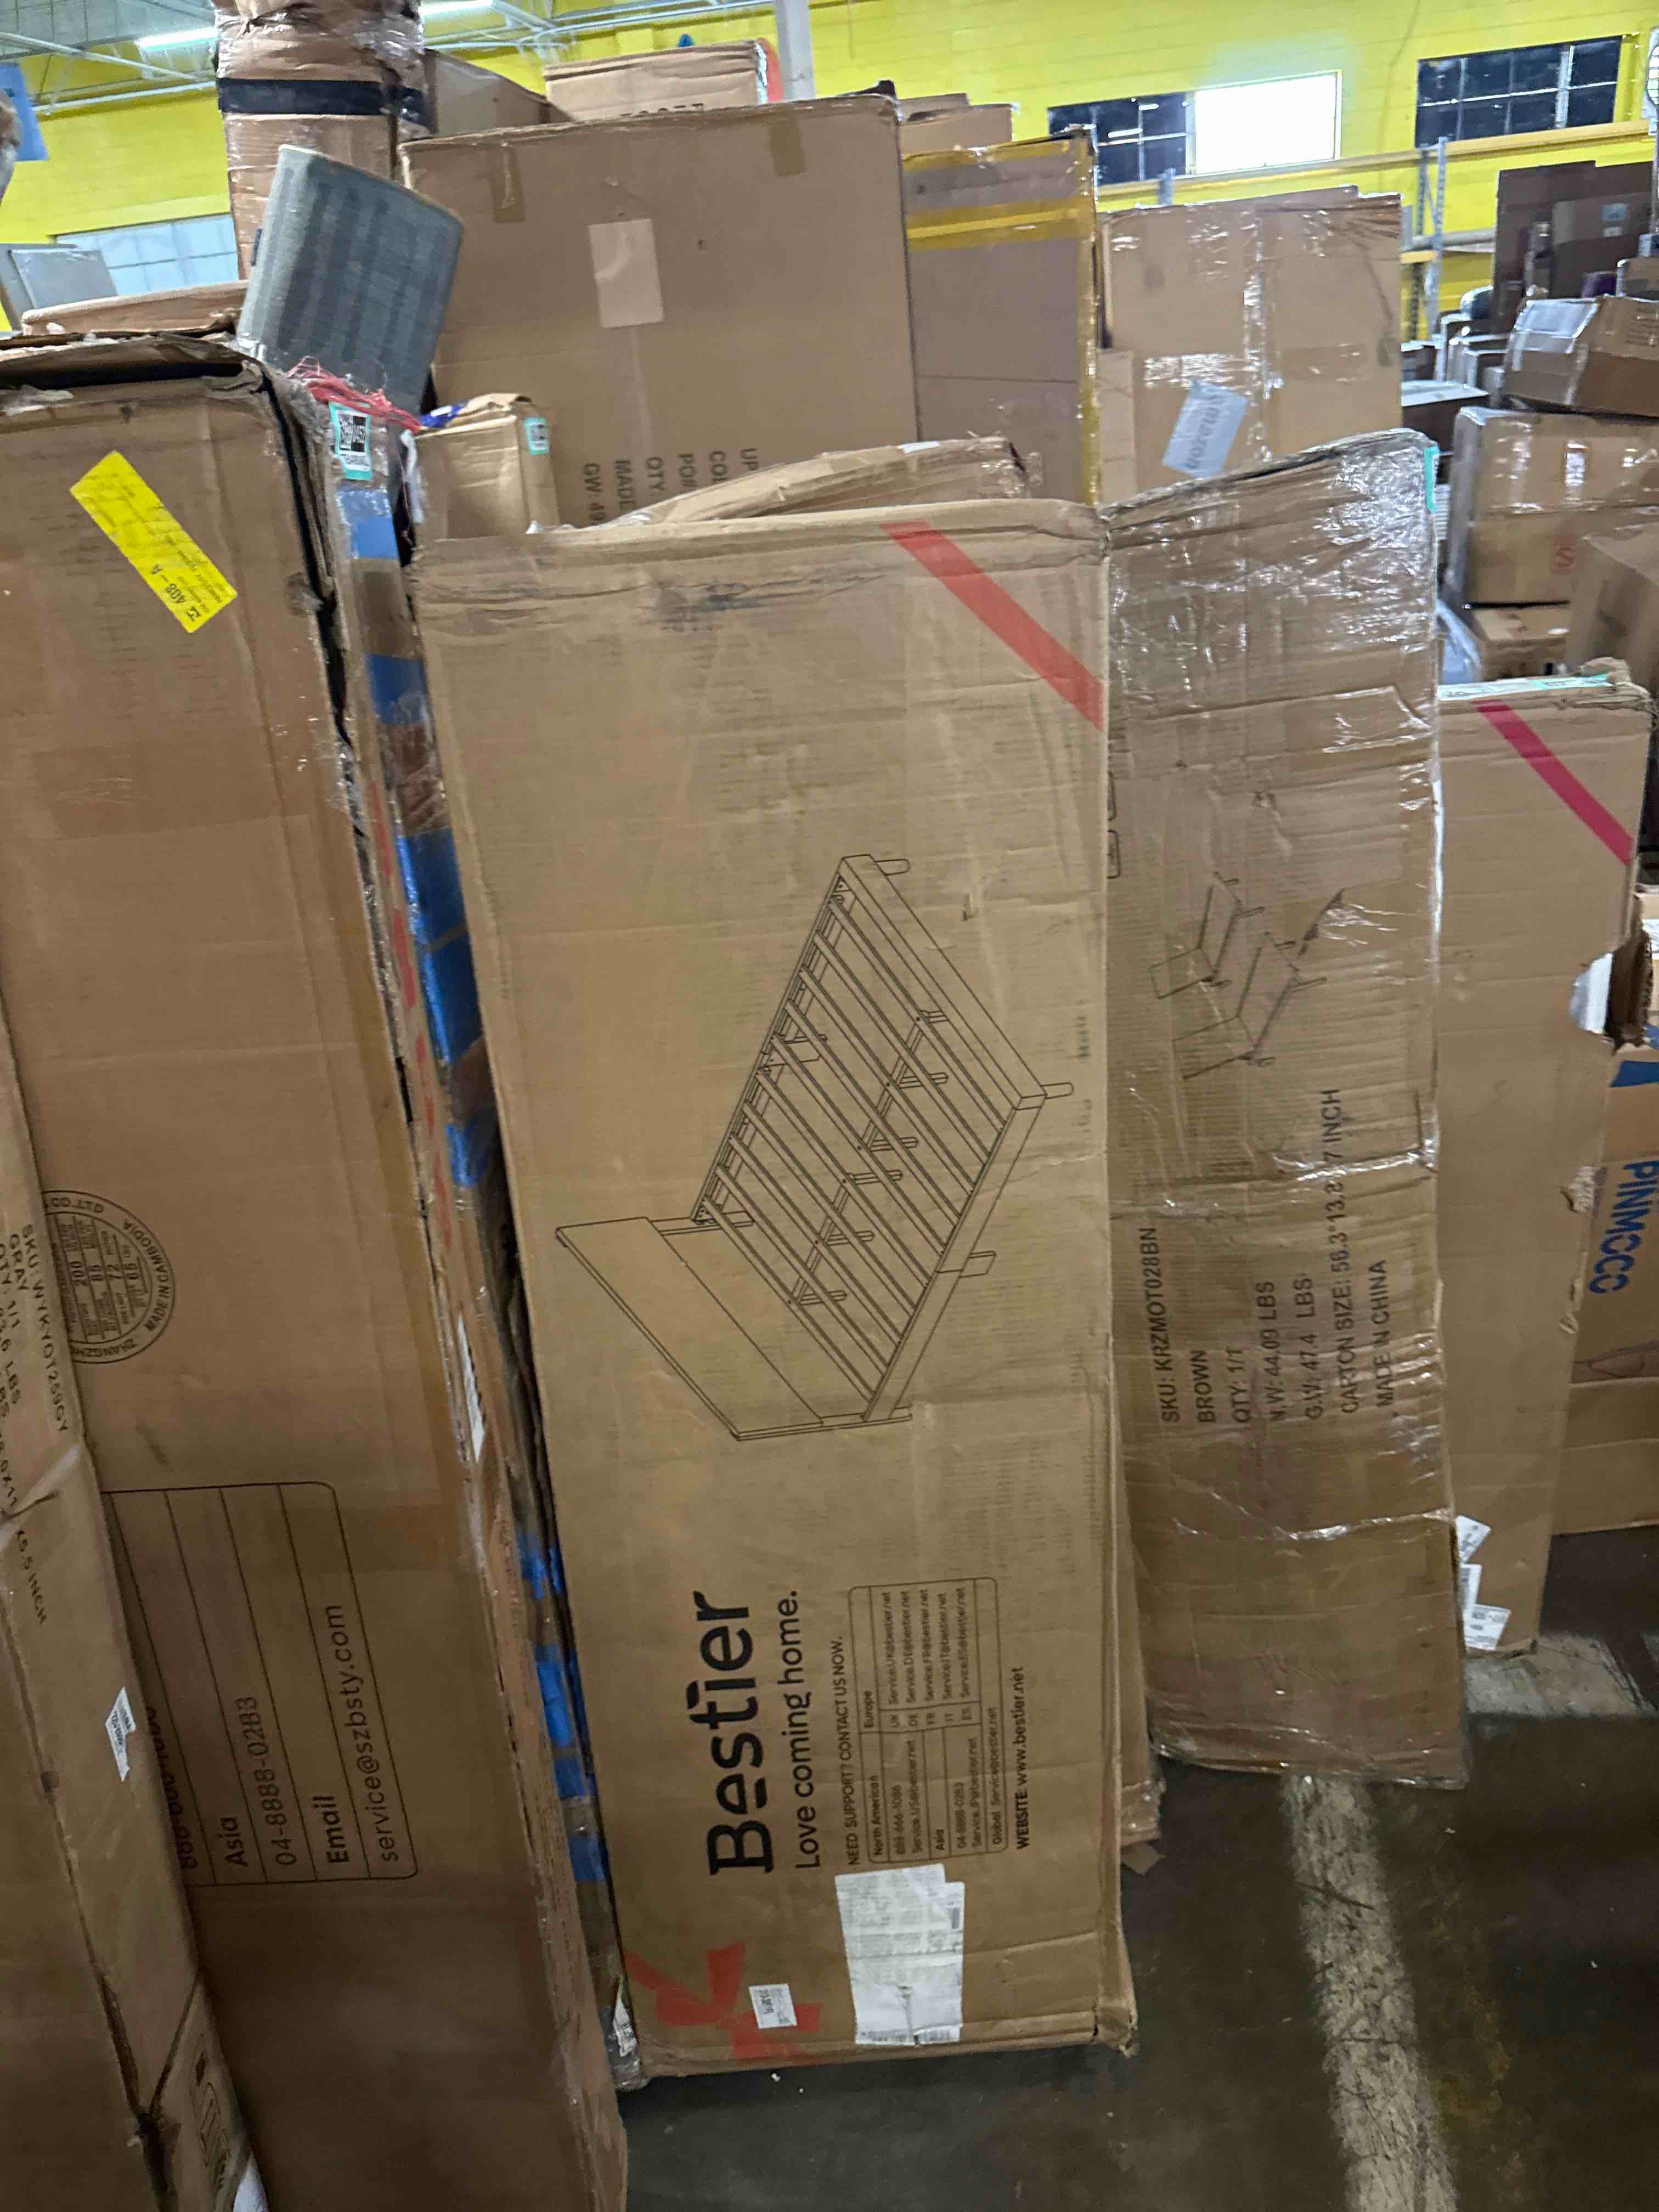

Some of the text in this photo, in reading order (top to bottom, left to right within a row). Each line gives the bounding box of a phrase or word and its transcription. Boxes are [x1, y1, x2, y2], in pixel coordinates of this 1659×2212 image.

[1321, 1089, 1344, 1144] INCH
[1255, 1281, 1278, 1321] LBS
[1293, 1277, 1315, 1318] LBS
[1331, 1280, 1355, 1331] SIZE:
[1368, 1259, 1390, 1325] CHINA
[1159, 1377, 1180, 1423] SKU:
[1189, 1350, 1216, 1423] BROWN
[1226, 1347, 1251, 1424] QTY: 1/1
[1337, 1337, 1360, 1414] CARTON
[1373, 1350, 1394, 1408] MADE
[833, 1677, 847, 1697] US
[864, 1691, 874, 1728] Europe
[325, 1604, 400, 1863] service@szbsty.com
[685, 1590, 774, 1875] Bestier
[776, 1590, 821, 1869] Love coming home.
[834, 1700, 851, 1760] CONTACT
[1011, 1666, 1028, 1786] www.bestier.net
[235, 1696, 297, 1866] 04-8888-0283
[220, 1816, 248, 1867] Asia
[312, 1795, 349, 1865] Email
[845, 1833, 861, 1866] NEED
